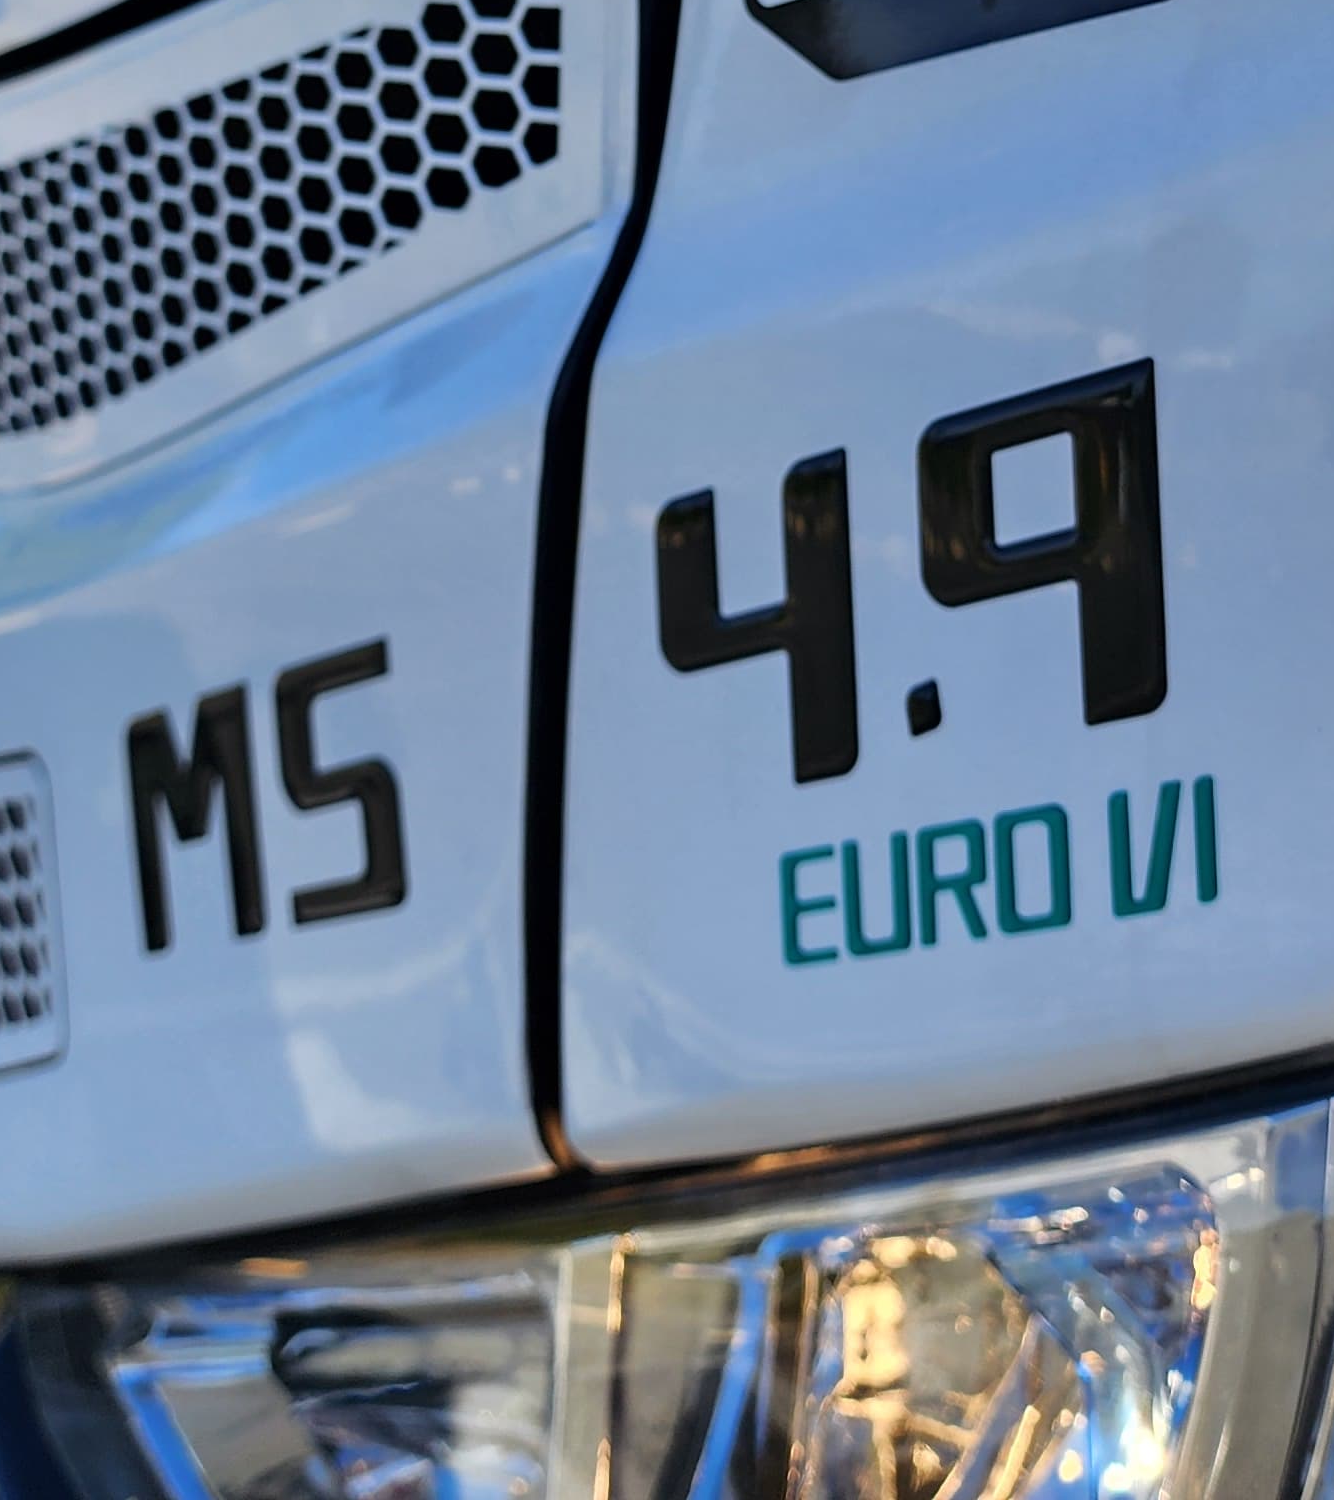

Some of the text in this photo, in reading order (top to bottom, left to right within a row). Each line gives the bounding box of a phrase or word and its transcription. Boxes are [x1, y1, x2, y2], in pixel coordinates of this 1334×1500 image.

[125, 357, 1168, 954] MS 4.9
[780, 774, 1219, 967] EURO VI
